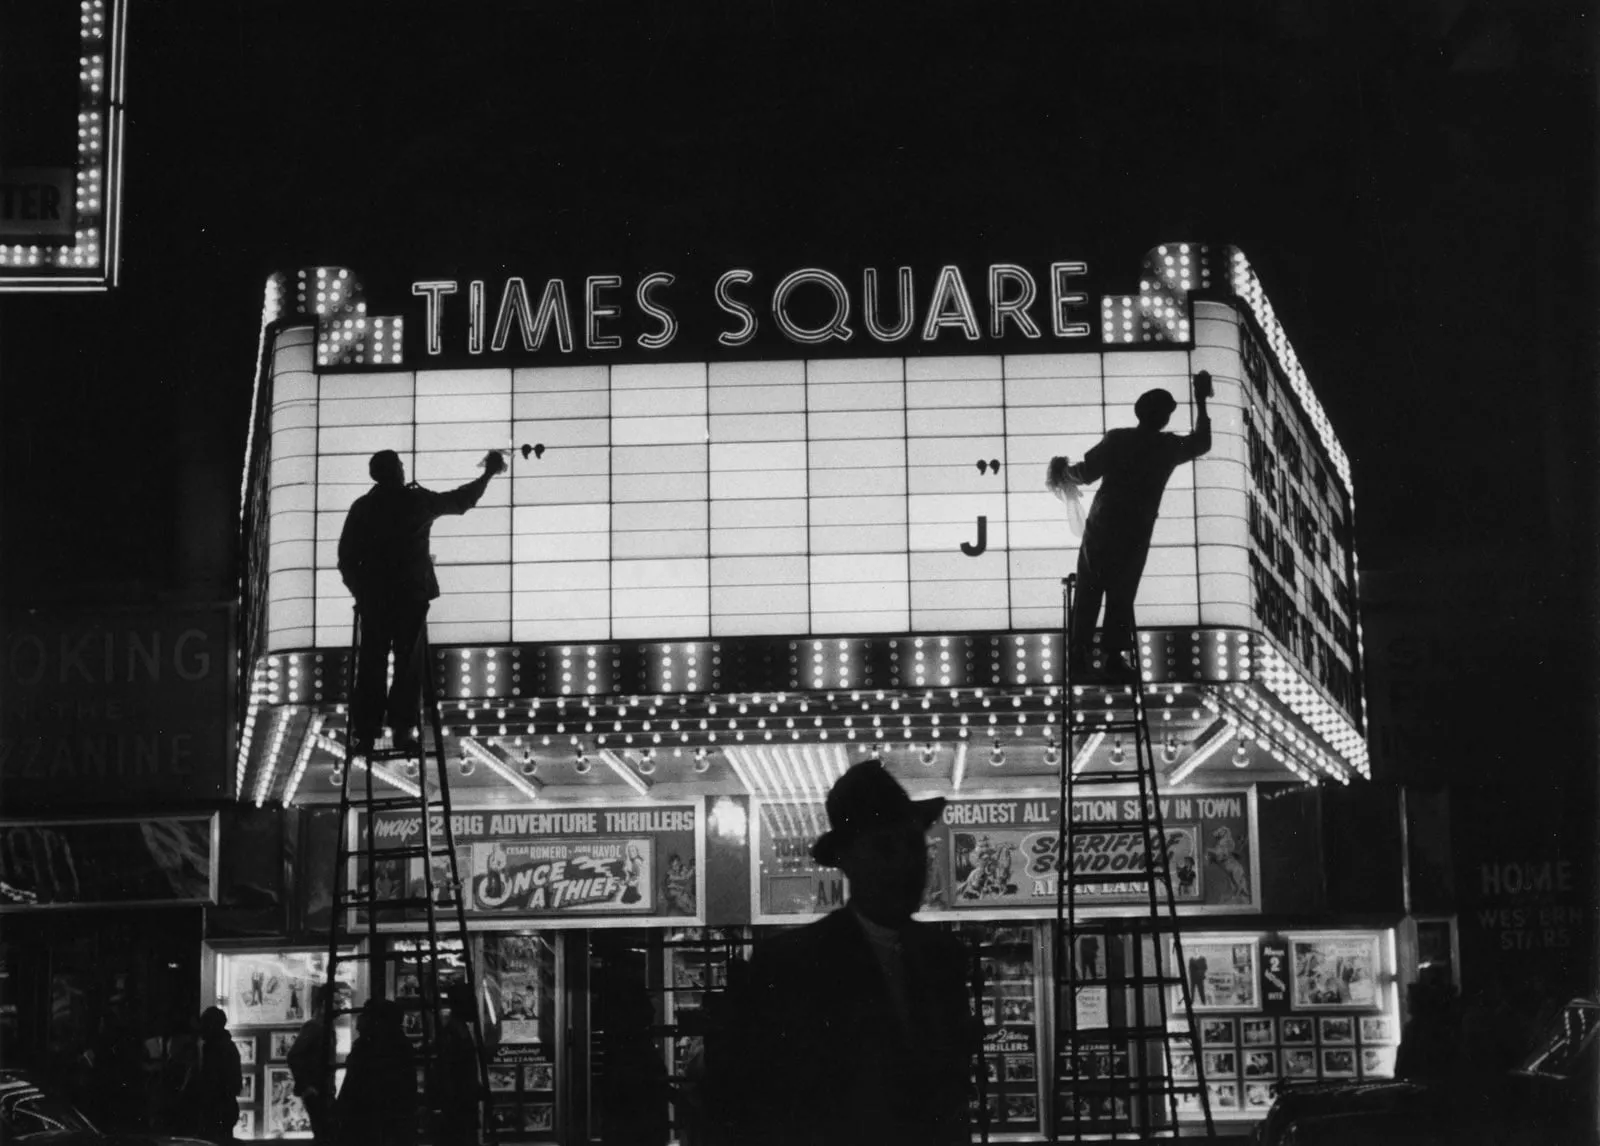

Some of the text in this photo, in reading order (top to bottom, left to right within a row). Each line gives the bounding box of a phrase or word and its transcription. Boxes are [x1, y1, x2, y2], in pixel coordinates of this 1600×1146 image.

[411, 262, 1090, 355] TIMES SQUARE
[960, 515, 986, 557] J
[430, 817, 444, 835] 2
[451, 815, 484, 835] BIG
[489, 813, 597, 834] ADVENTURE
[604, 811, 695, 832] THRILLERS
[942, 803, 1018, 825] GREATEST
[1175, 799, 1192, 820] IN
[1197, 798, 1241, 818] TOWN
[530, 845, 567, 859] ROMERO
[479, 861, 568, 906] ONCE
[529, 876, 621, 909] A THIEF
[1480, 860, 1574, 896] HOME
